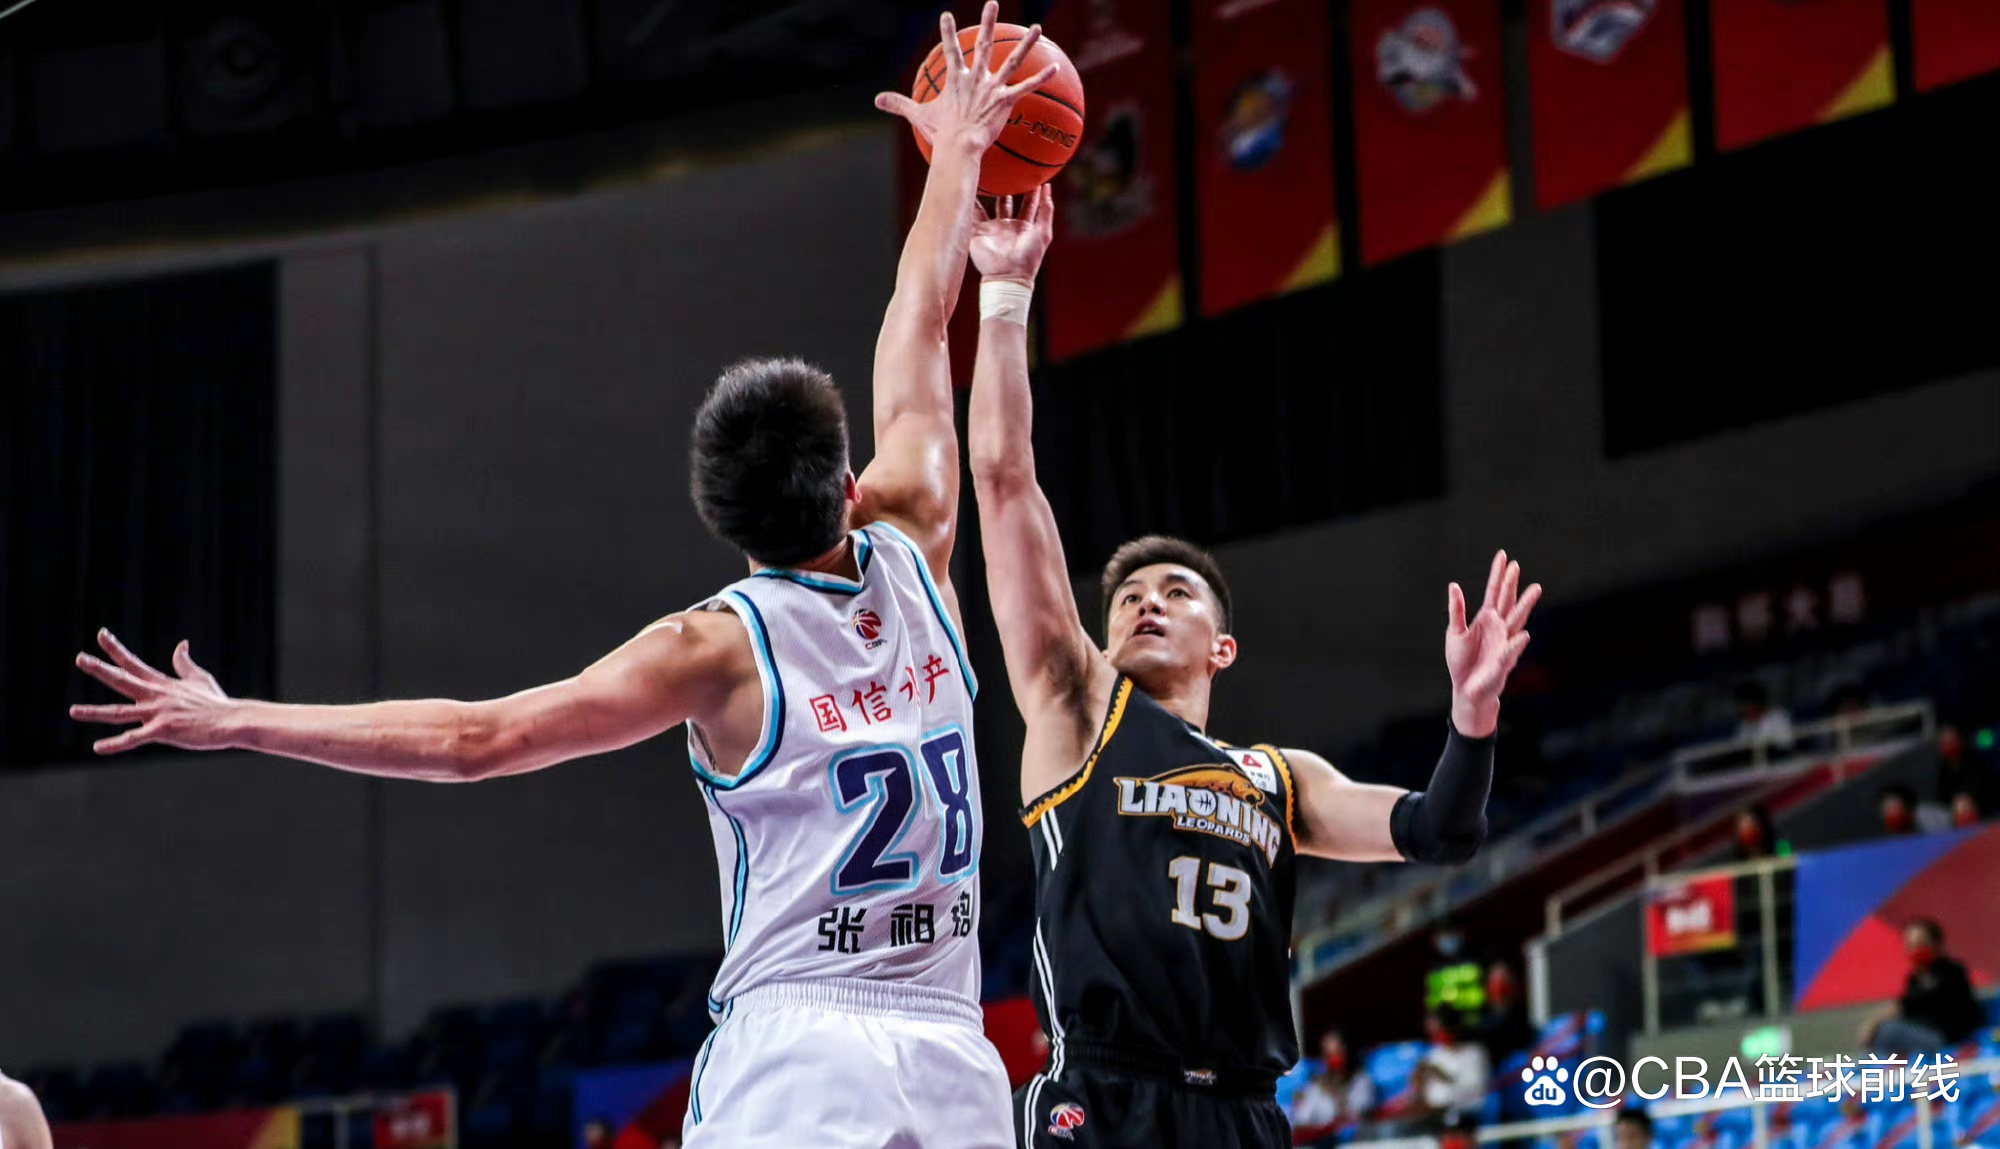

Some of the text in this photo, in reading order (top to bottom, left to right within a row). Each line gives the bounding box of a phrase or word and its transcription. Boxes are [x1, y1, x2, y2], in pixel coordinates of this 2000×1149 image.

[1007, 113, 1078, 149] I-NING
[829, 722, 979, 896] 28
[1113, 778, 1282, 868] LIAONING
[1175, 815, 1252, 845] LEOPARDS
[1168, 856, 1252, 941] 13
